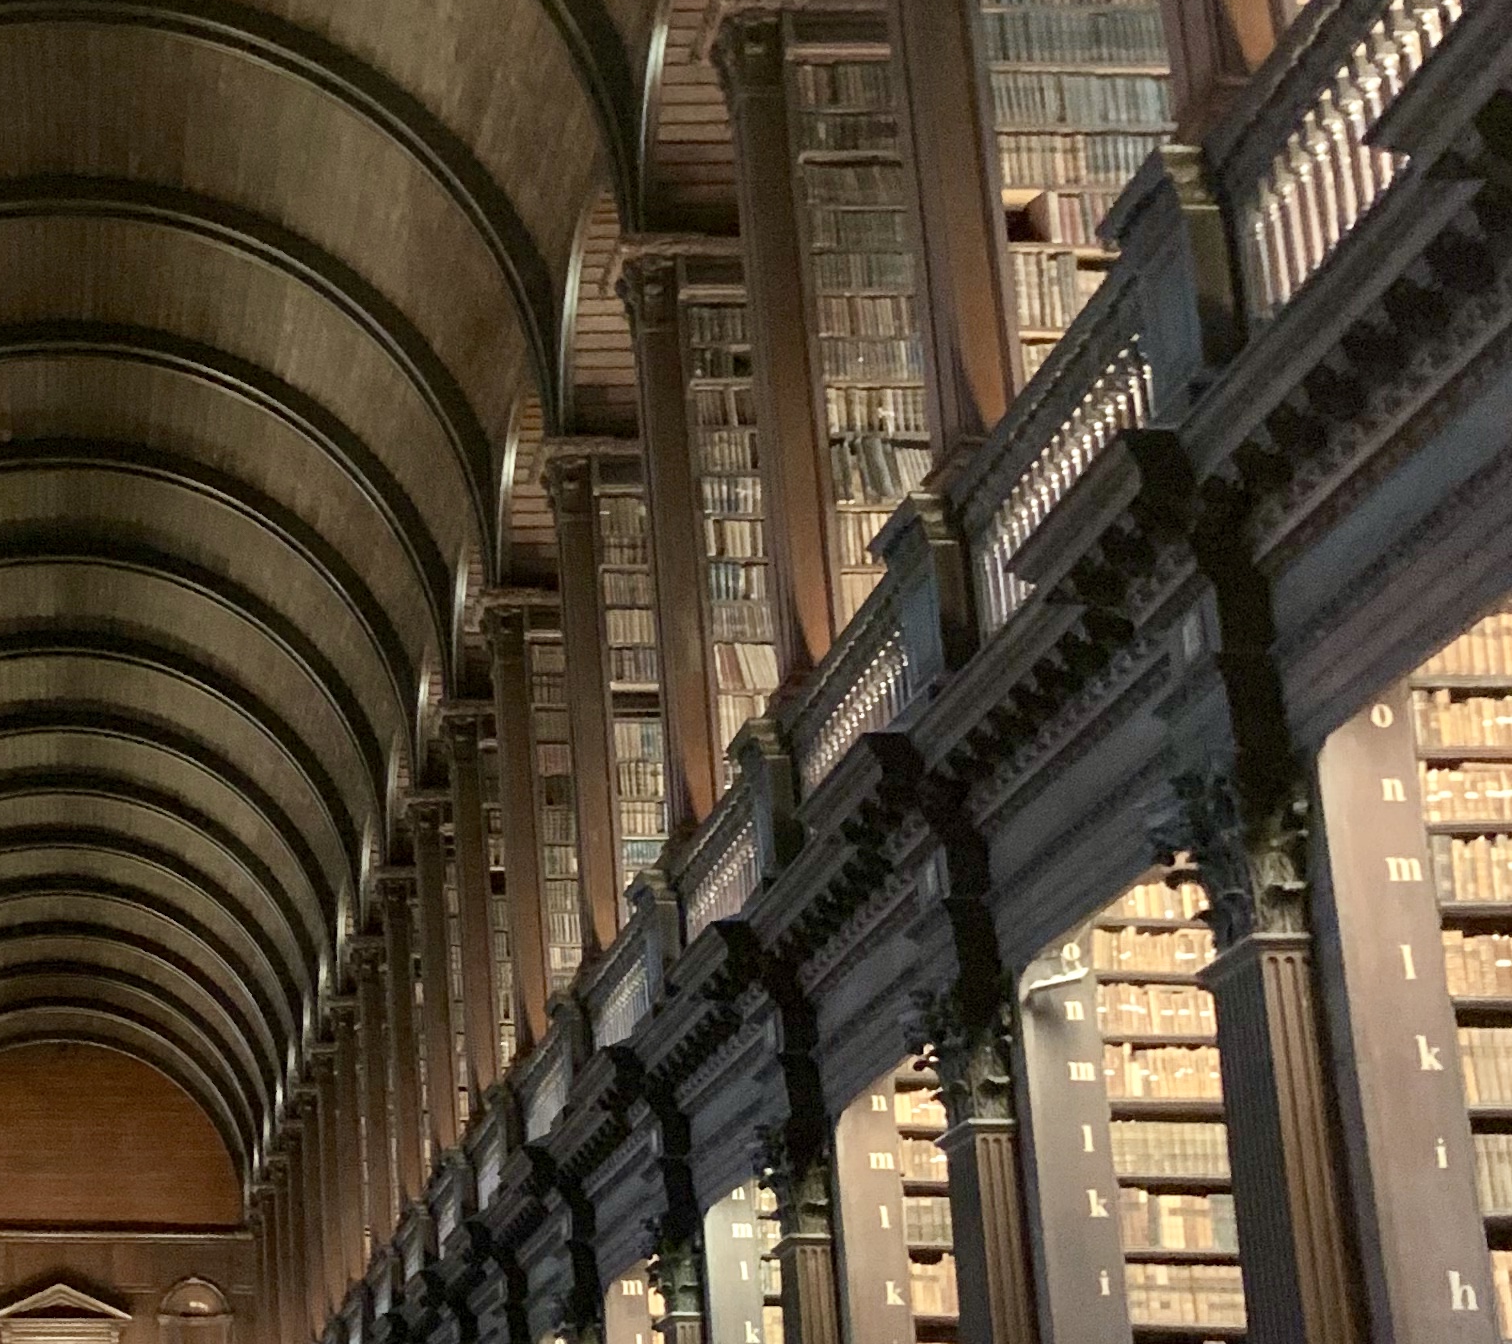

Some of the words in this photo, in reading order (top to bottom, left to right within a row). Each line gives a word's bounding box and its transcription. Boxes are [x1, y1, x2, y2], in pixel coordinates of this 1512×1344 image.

[1370, 705, 1393, 728] o
[1382, 779, 1406, 801] n
[1386, 857, 1422, 881] m
[1065, 1001, 1084, 1020] n
[1416, 1035, 1443, 1070] k
[1069, 1062, 1095, 1081] m
[872, 1096, 887, 1111] n
[870, 1153, 894, 1169] m
[1436, 1138, 1447, 1168] i
[1087, 1190, 1108, 1217] k
[732, 1224, 752, 1238] m
[622, 1280, 643, 1295] m
[886, 1281, 904, 1305] k
[1100, 1271, 1110, 1295] i
[1449, 1271, 1478, 1310] h
[745, 1321, 760, 1343] k
